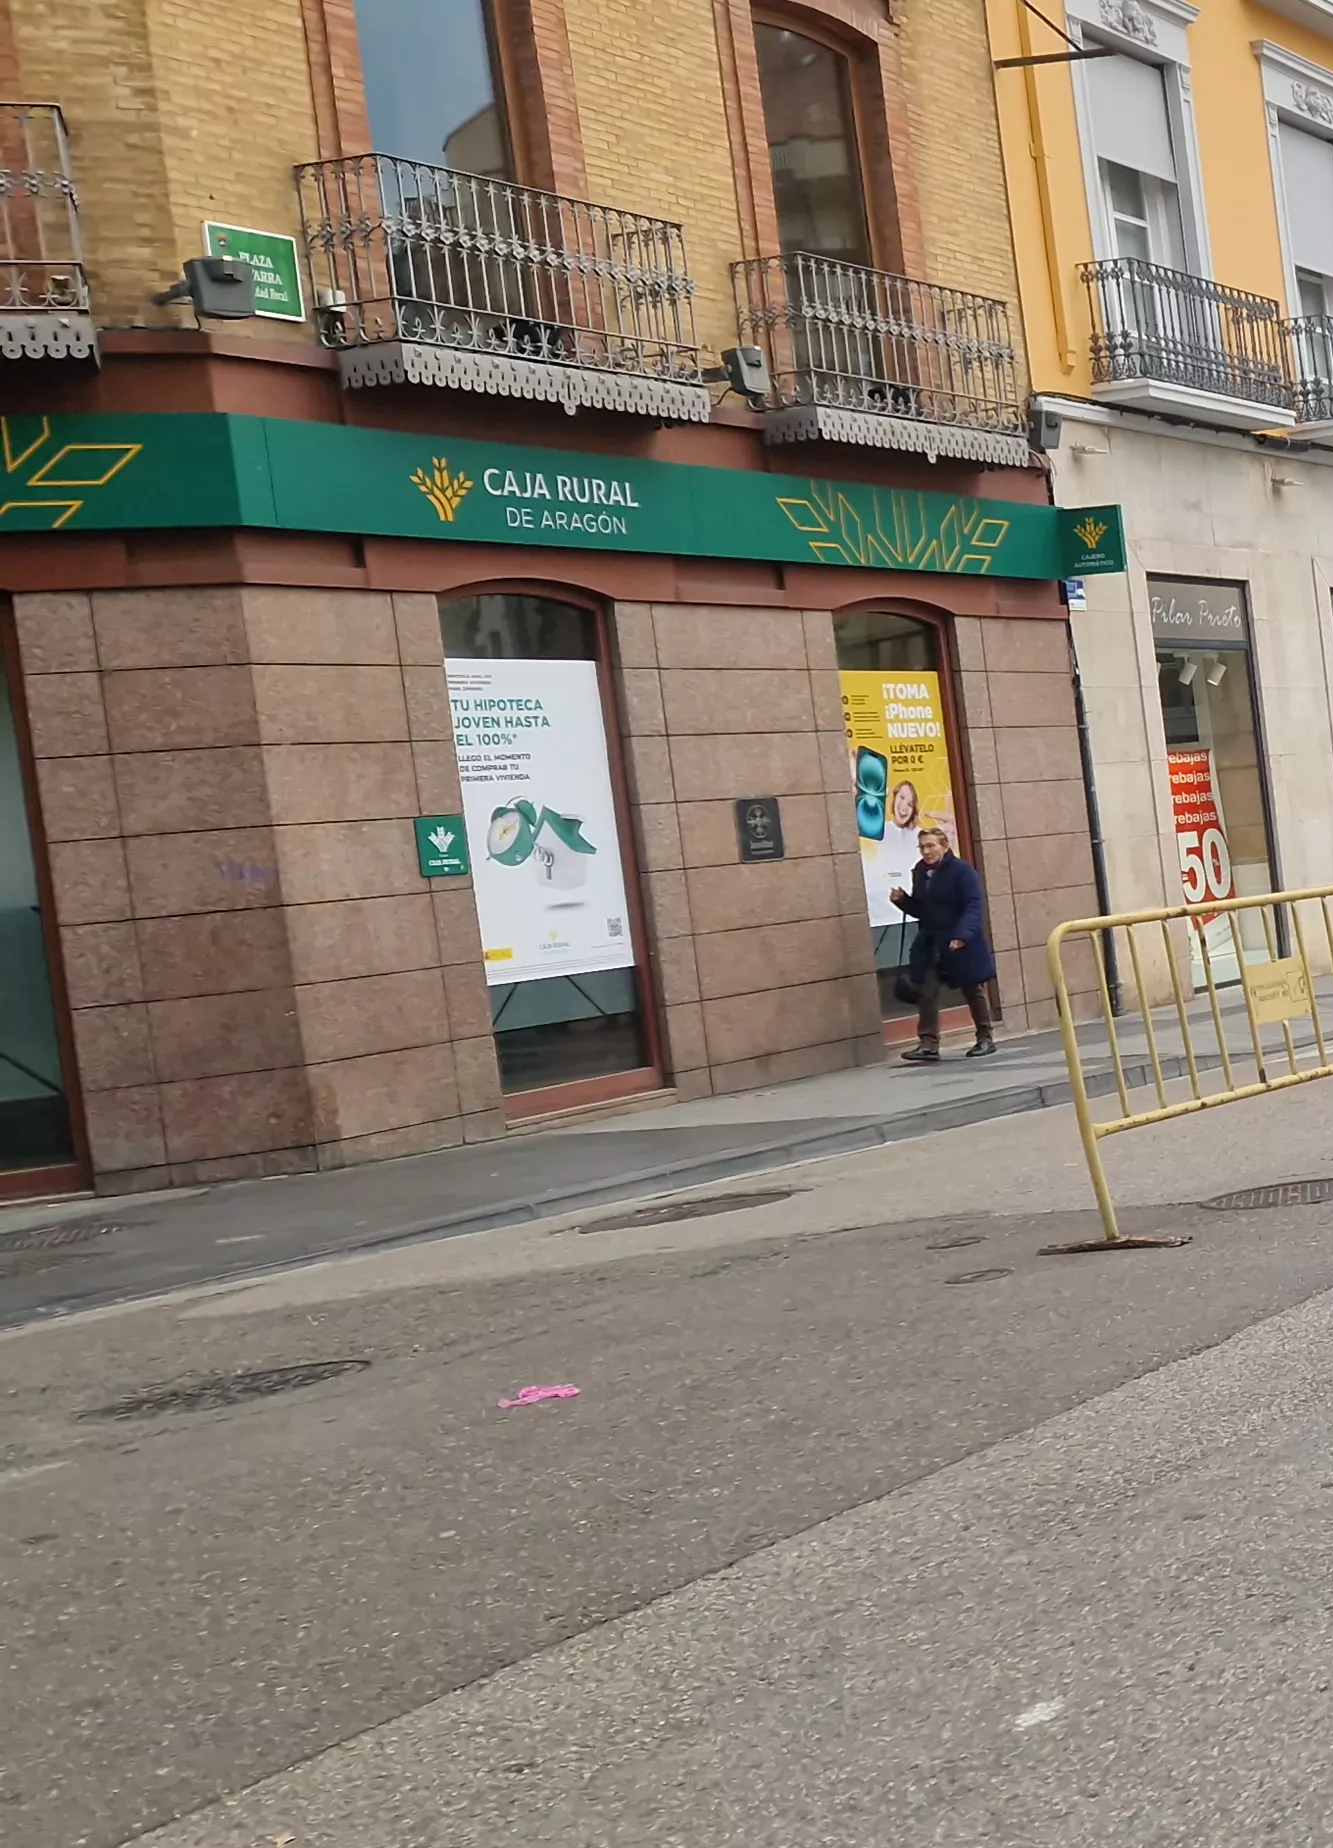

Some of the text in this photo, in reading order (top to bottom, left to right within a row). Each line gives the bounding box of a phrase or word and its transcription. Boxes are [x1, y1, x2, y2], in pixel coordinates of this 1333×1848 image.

[238, 251, 275, 268] PLAZA
[252, 269, 284, 285] ARRA
[483, 468, 640, 508] CAJA RURAL
[506, 507, 627, 535] DE ARAGÓN
[1151, 596, 1241, 628] Pilar Prieto
[451, 699, 544, 712] TU HIPOTECA
[885, 702, 933, 719] iPhone
[454, 716, 551, 729] JOVEN HASTA
[887, 721, 941, 738] NUEVO!
[456, 734, 473, 746] EL
[494, 753, 532, 761] MOMENTO
[891, 756, 909, 765] POR
[1168, 751, 1208, 766] ebajas
[472, 763, 507, 772] COMPRAR
[460, 773, 531, 783] PRIMERA VIVIENDA
[1171, 791, 1214, 806] rebajas
[1174, 810, 1217, 825] rebajas
[1177, 828, 1232, 903] 50
